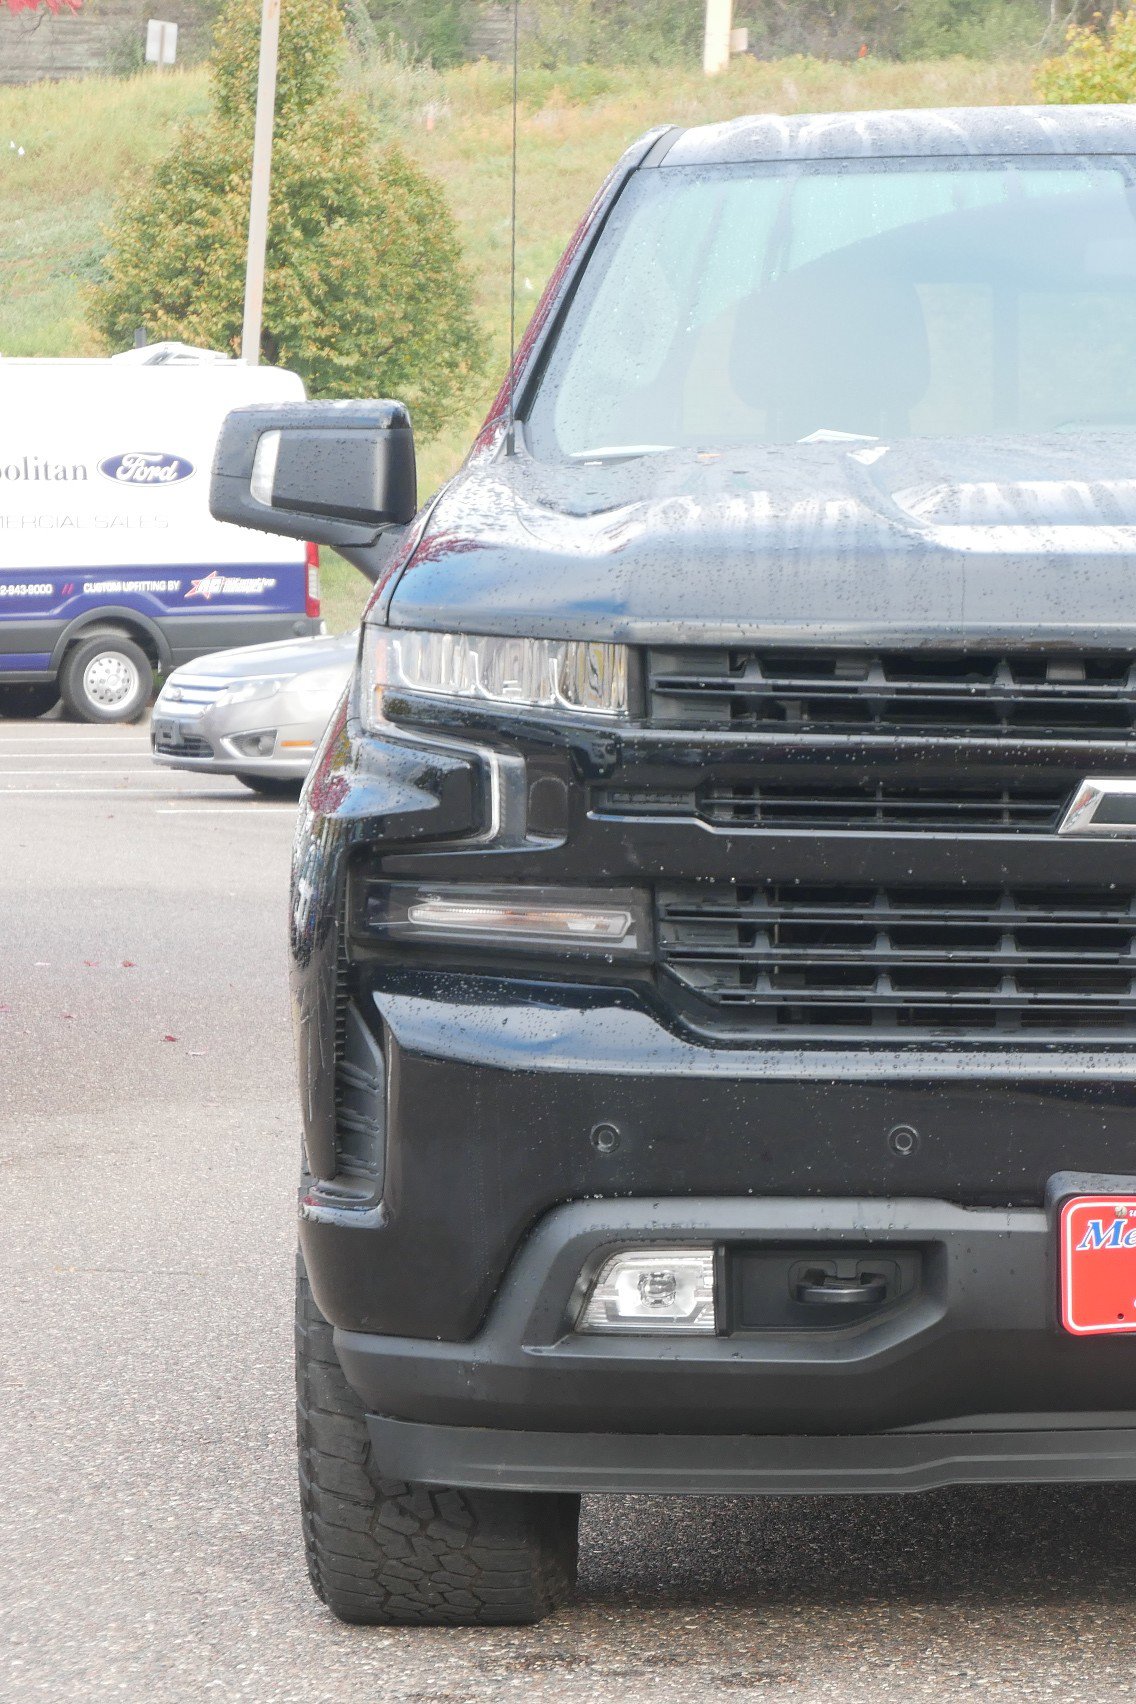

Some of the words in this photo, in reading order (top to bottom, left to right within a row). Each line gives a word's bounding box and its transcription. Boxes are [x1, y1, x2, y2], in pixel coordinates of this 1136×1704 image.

[0, 456, 88, 482] olitan
[115, 452, 181, 483] Ford
[94, 515, 169, 529] SALES
[167, 580, 180, 592] BY
